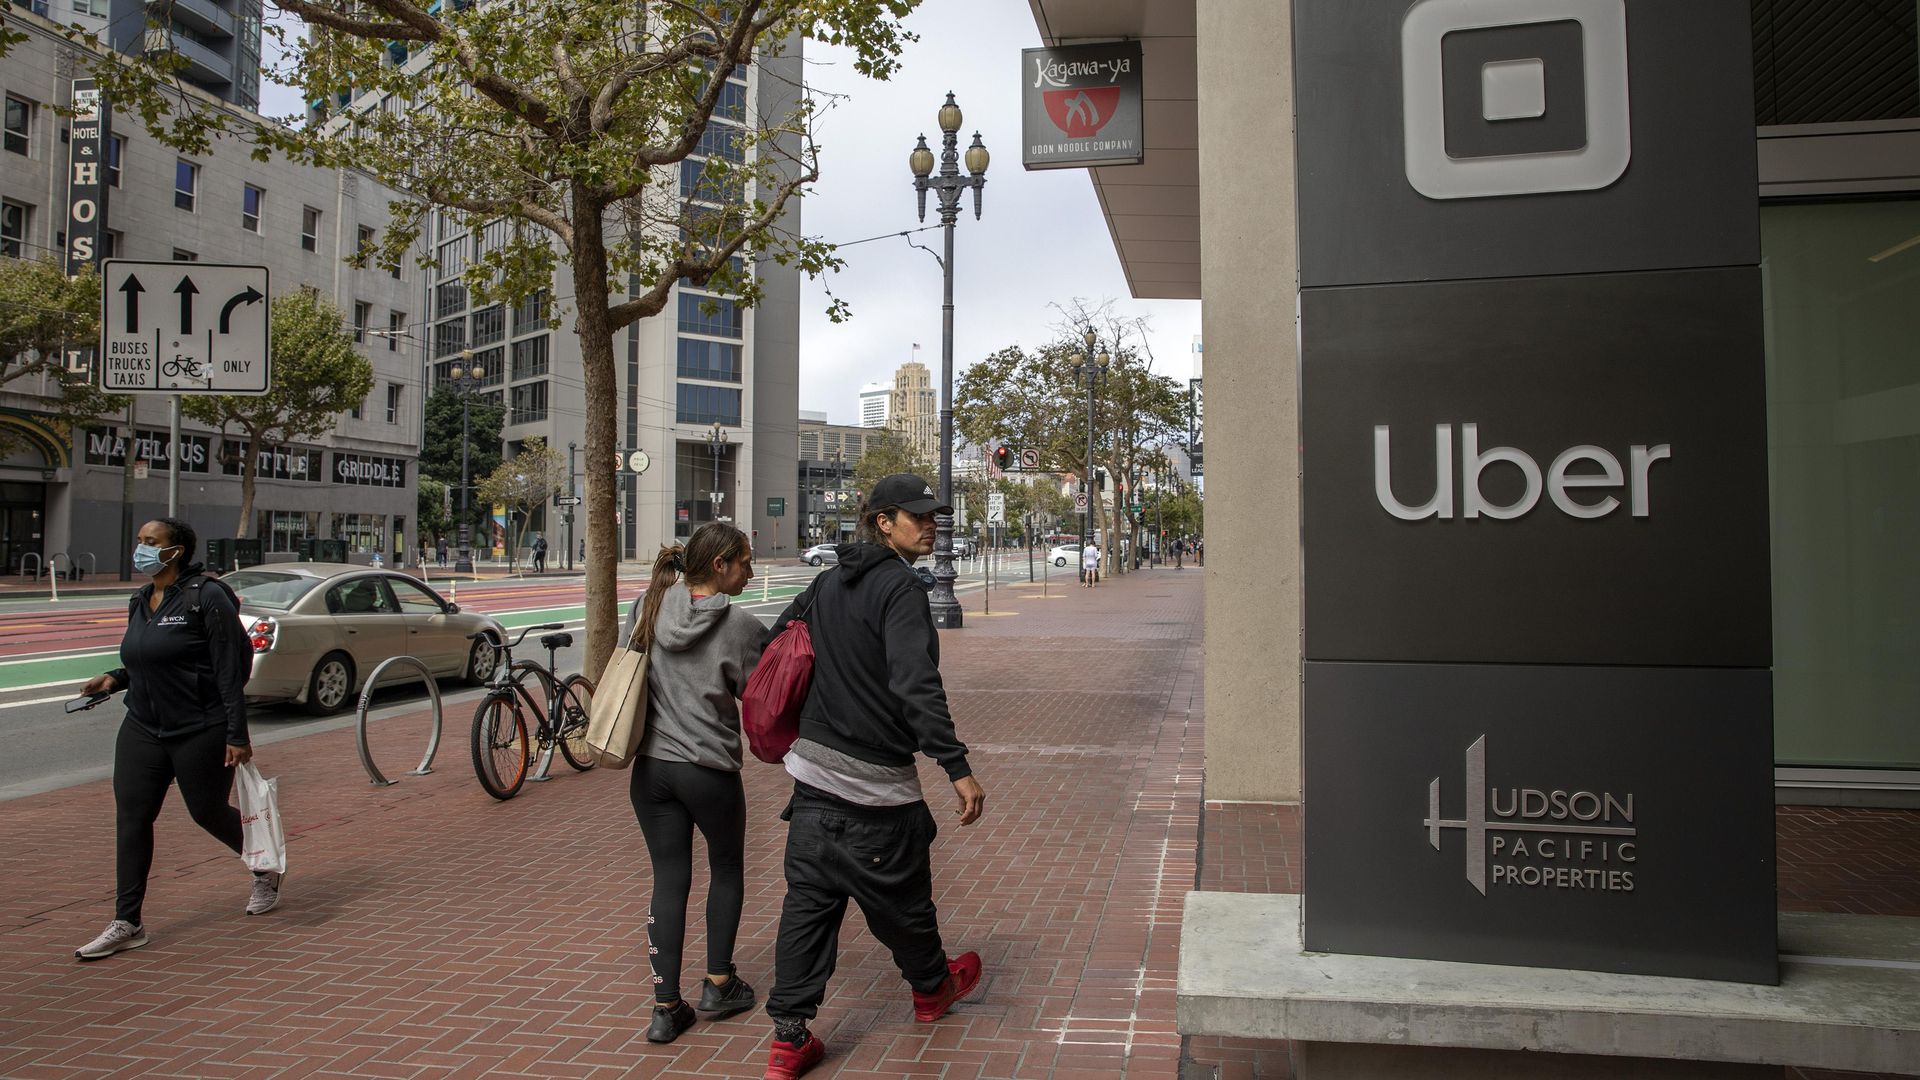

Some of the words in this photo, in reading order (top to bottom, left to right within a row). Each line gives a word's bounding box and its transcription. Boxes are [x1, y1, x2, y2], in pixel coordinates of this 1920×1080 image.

[1033, 57, 1131, 88] Kagawa-ya
[73, 127, 99, 139] HOTEL
[80, 145, 94, 156] &
[1032, 144, 1055, 155] UDON
[1058, 141, 1090, 153] NOODLE
[1093, 139, 1134, 152] COMPANY
[111, 341, 149, 355] BUSES
[108, 357, 152, 371] TRUCKS
[223, 360, 252, 373] ONLY
[113, 373, 146, 386] TAXIS
[337, 459, 401, 482] GRIDDLE
[168, 615, 185, 623] WCN
[1491, 836, 1636, 862] PACIFIC
[1492, 865, 1635, 891] PROPERTIES
